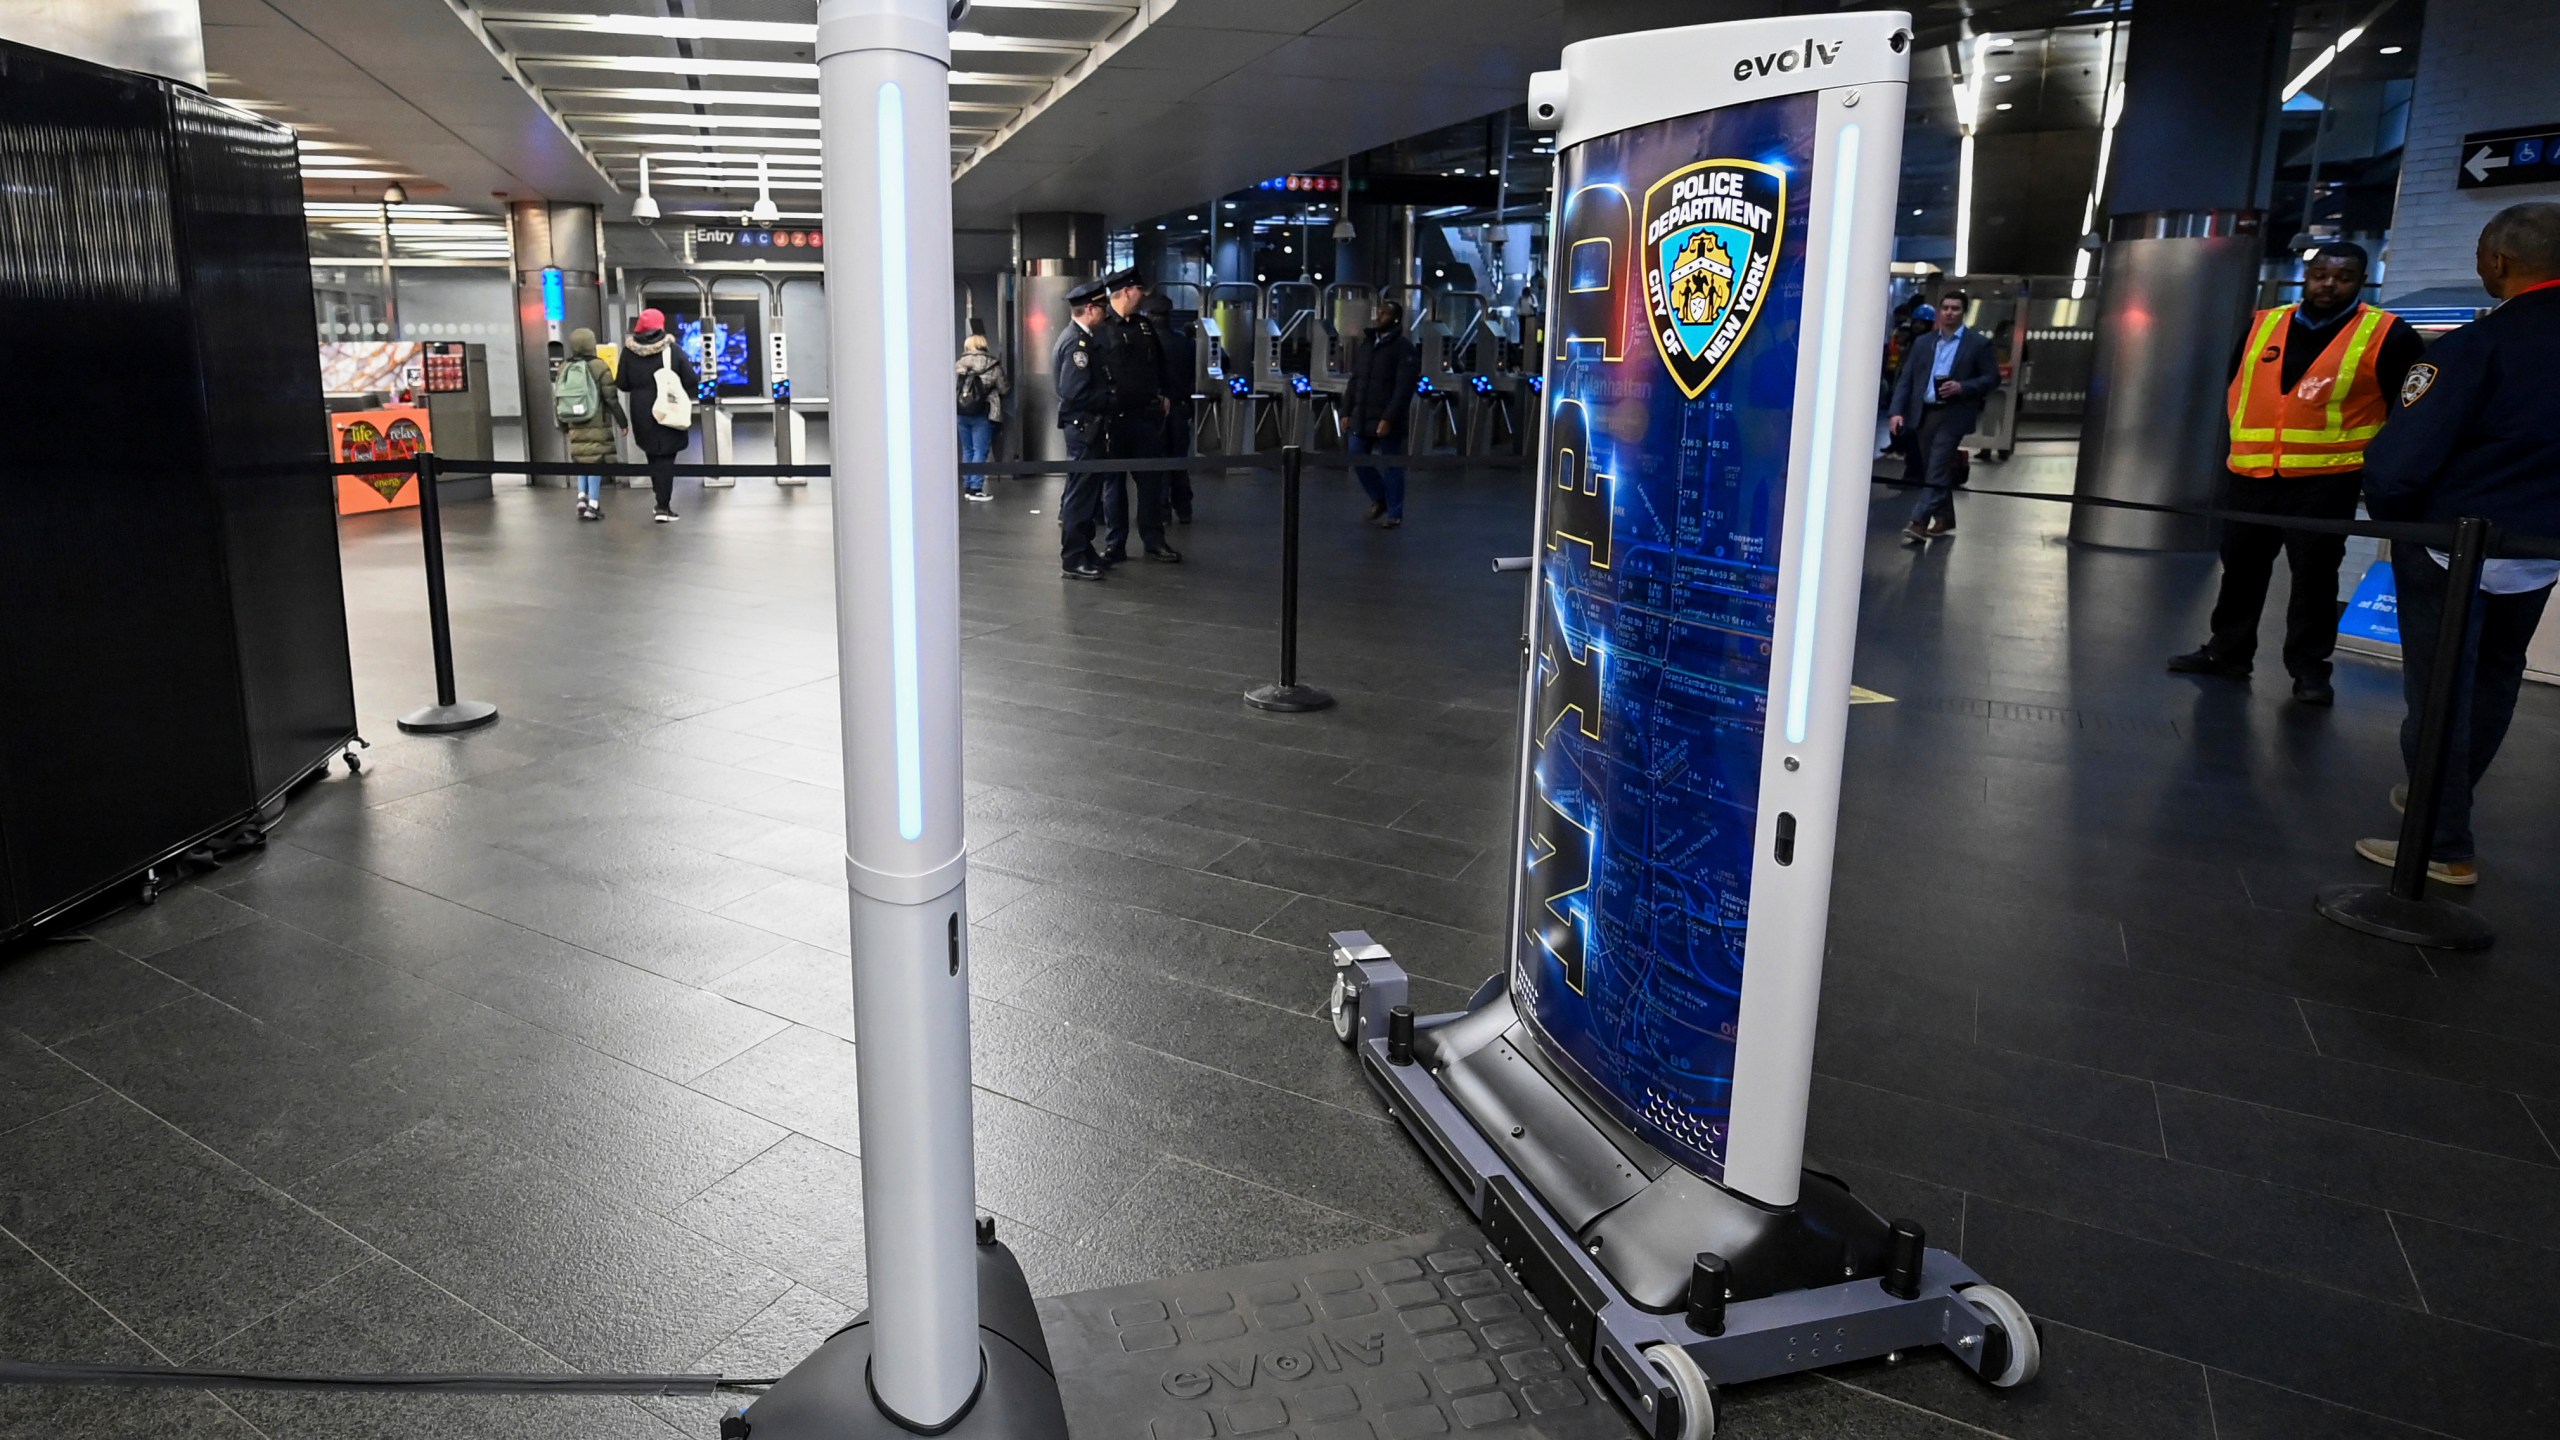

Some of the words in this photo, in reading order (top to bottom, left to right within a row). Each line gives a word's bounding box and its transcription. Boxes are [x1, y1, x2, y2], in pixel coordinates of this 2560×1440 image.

[1733, 38, 1843, 81] evolv
[1671, 171, 1744, 206] POLICE
[1647, 197, 1772, 246] DEPARTMENT
[697, 229, 734, 245] Entry
[1647, 268, 1667, 319] CITY
[1662, 331, 1682, 357] OF
[1704, 319, 1743, 365] NEW
[1734, 253, 1770, 315] YORK
[1584, 374, 1652, 398] Manhattan
[1716, 402, 1724, 411] 96
[1725, 403, 1733, 412] St
[352, 425, 373, 442] life
[390, 426, 417, 440] relax
[1722, 441, 1730, 450] St
[1691, 490, 1698, 499] St
[1708, 510, 1715, 519] 72
[1717, 510, 1724, 520] St
[1729, 532, 1764, 545] Roosevelt
[1678, 564, 1708, 576] Lexington
[1729, 572, 1737, 581] St
[2372, 602, 2393, 612] the
[1732, 616, 1740, 625] St
[1665, 671, 1683, 683] Grand
[1718, 685, 1727, 695] St
[1716, 780, 1725, 789] Av
[1692, 921, 1712, 935] Grand
[1161, 1332, 1385, 1399] evolv
